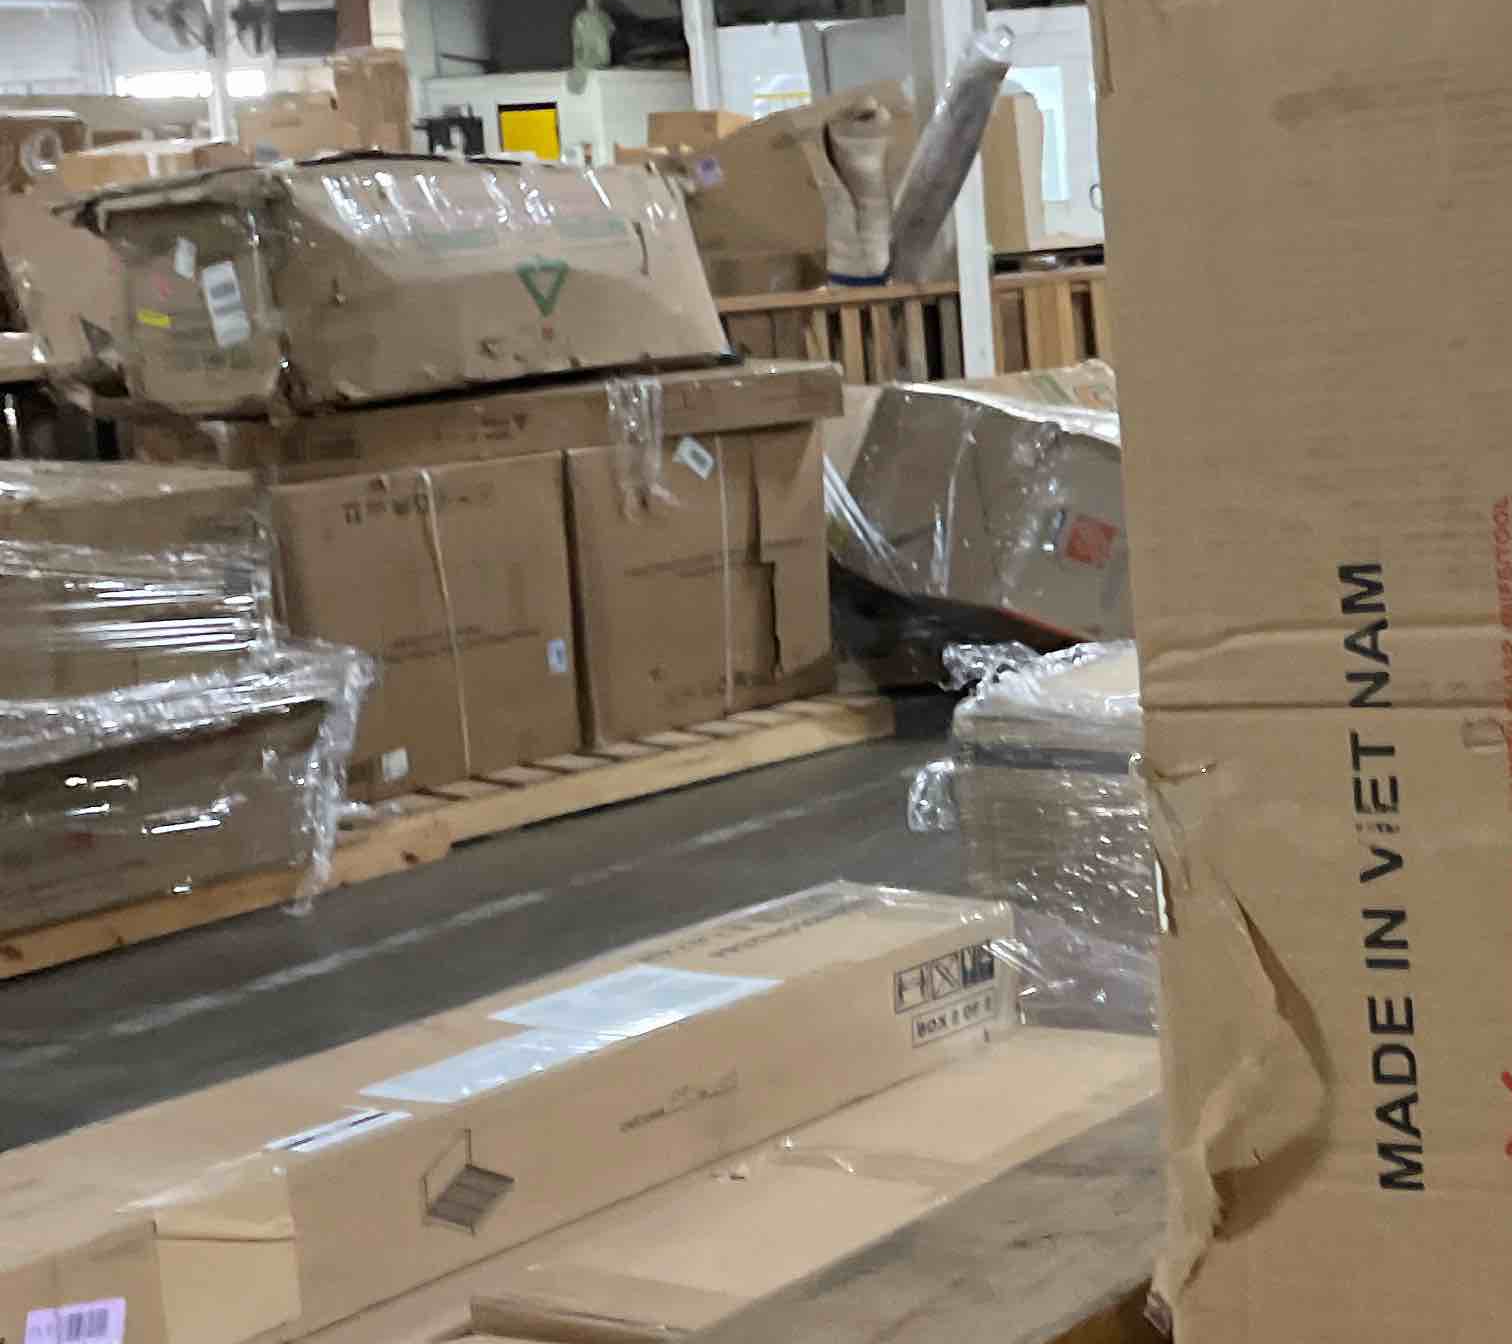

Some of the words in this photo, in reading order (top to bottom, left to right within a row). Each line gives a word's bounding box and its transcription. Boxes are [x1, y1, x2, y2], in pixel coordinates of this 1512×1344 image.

[1337, 563, 1393, 709] NAM
[1349, 732, 1404, 885] VIET
[1360, 908, 1411, 972] IN
[1367, 994, 1427, 1193] MADE
